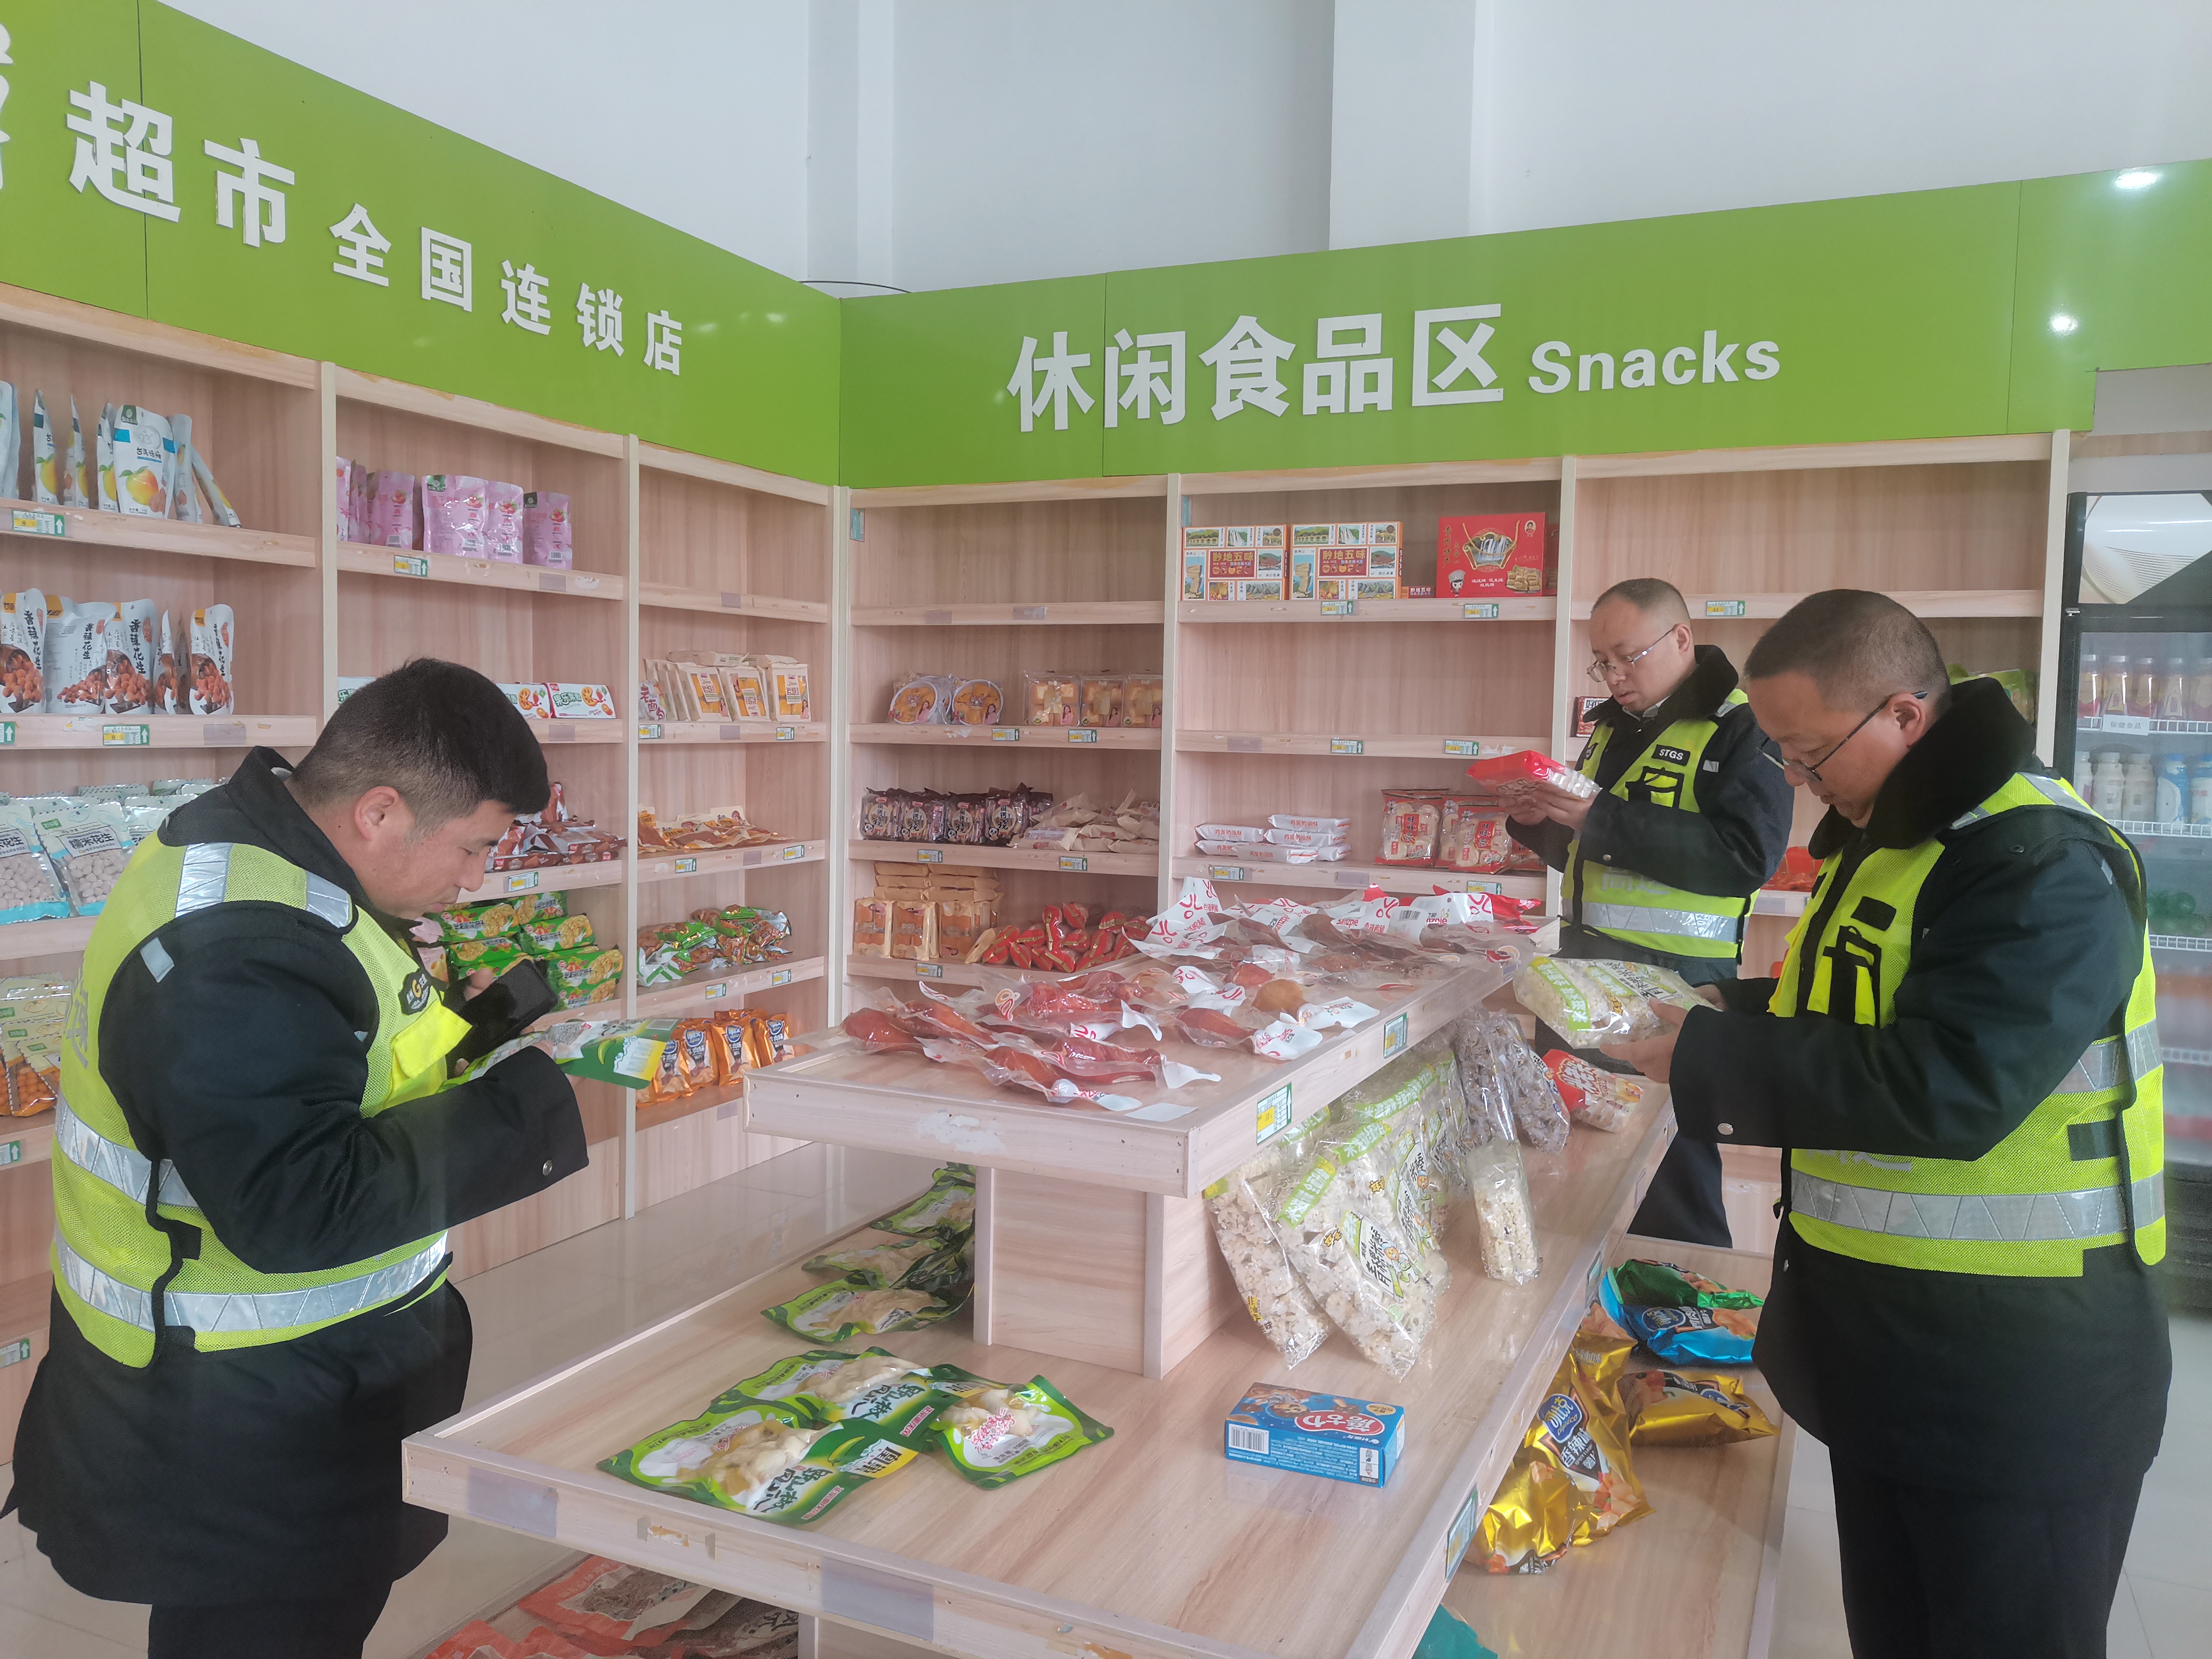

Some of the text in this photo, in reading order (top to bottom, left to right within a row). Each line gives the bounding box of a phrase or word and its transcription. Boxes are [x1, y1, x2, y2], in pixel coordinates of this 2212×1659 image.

[66, 80, 295, 247] 超市
[329, 203, 683, 375] 全国连锁店
[1007, 304, 1780, 433] 休闲食品区 Snacks
[1213, 552, 1253, 562] 黔地五味
[1322, 550, 1366, 560] 黔地五味
[129, 619, 146, 674] 香辣花生
[1659, 748, 1683, 760] STGS
[69, 833, 115, 850] 糯米花生
[1303, 1414, 1373, 1433] 蘑古力
